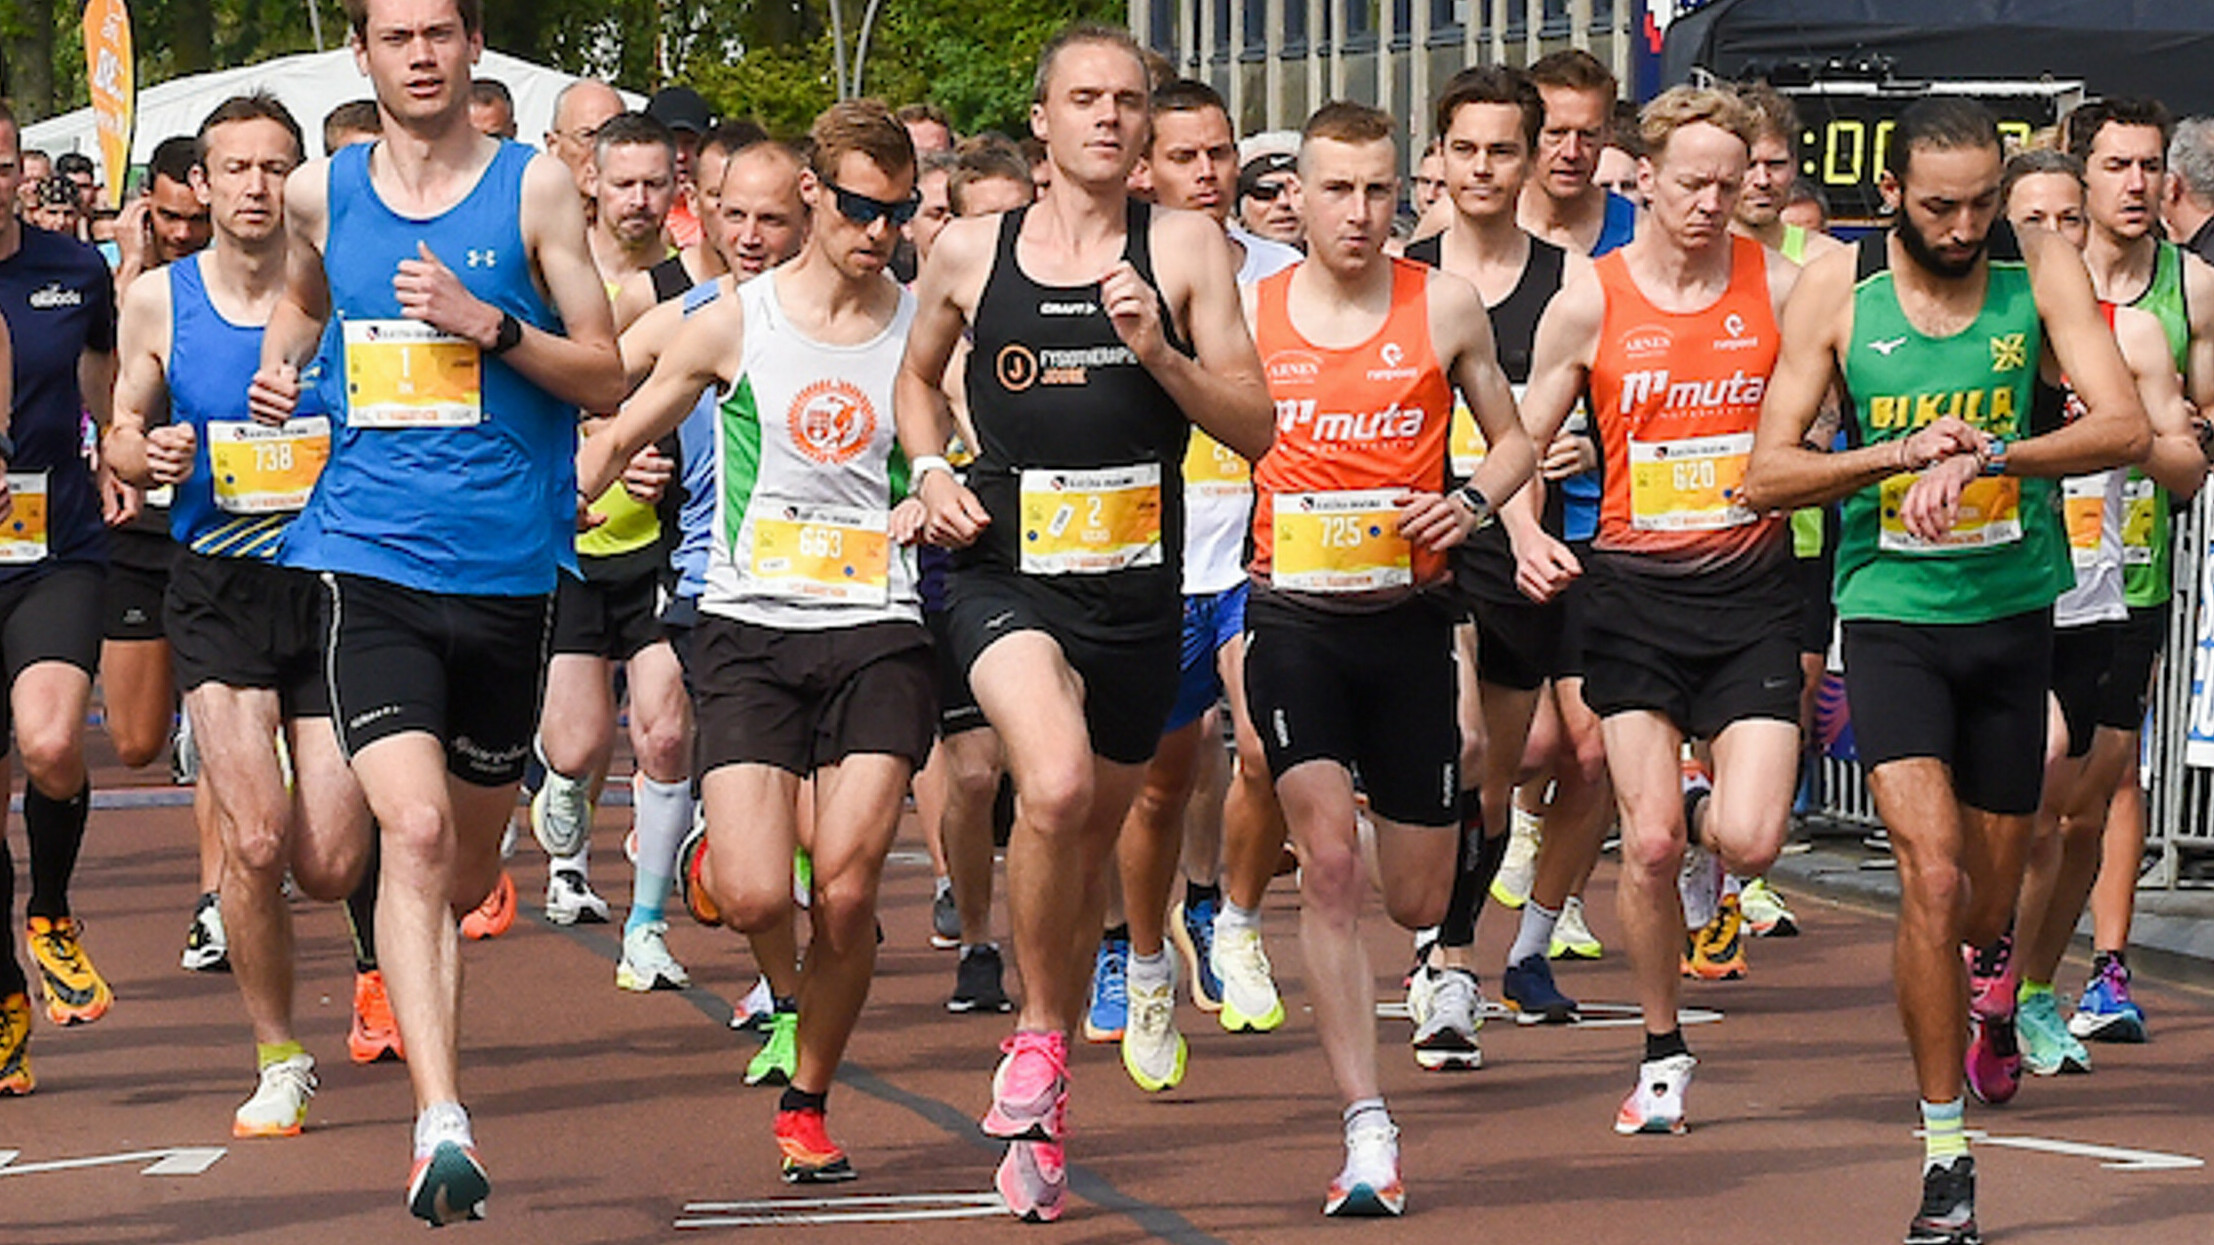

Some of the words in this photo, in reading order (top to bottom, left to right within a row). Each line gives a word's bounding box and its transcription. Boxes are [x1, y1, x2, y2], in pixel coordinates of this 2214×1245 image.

[400, 346, 410, 379] 1
[1009, 356, 1024, 379] J
[1665, 370, 1764, 408] muta
[1312, 402, 1424, 440] muta
[1870, 386, 2014, 428] BIKILA
[252, 443, 295, 472] 738
[1673, 460, 1716, 491] 620
[1087, 496, 1102, 527] 2
[1320, 515, 1361, 547] 725
